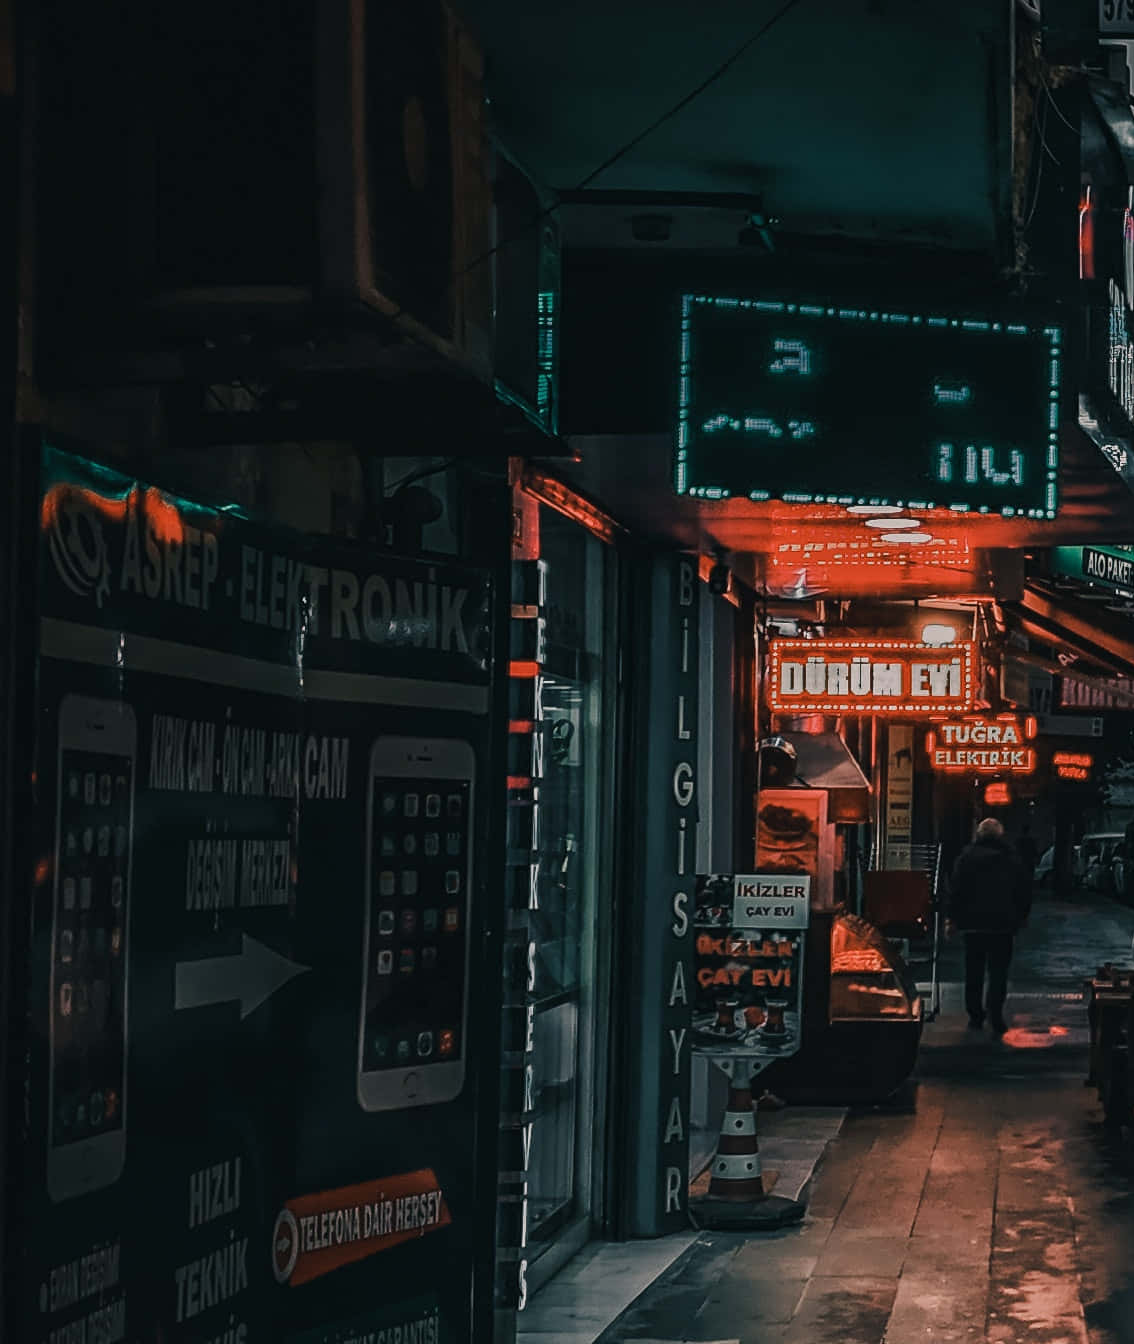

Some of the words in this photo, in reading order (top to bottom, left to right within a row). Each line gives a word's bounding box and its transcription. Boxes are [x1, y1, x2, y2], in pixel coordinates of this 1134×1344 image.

[1087, 550, 1106, 578] ALO
[240, 544, 472, 655] ELEKTRONİK
[780, 656, 903, 697] DÜRÜM
[911, 657, 961, 698] EVİ
[941, 720, 1019, 745] TUĞRA
[304, 735, 350, 799] CAM
[934, 747, 1024, 766] ELEKTRİK
[663, 560, 696, 1214] BİLGİSAYAR
[737, 881, 806, 898] İKİZLER
[745, 906, 771, 918] ÇAY
[774, 904, 795, 918] EVİ
[697, 967, 745, 990] ÇAY
[751, 967, 792, 988] EVİ
[189, 1155, 242, 1230] HIZLI
[299, 1206, 361, 1254] TELEFONA
[363, 1191, 393, 1239] DAİR
[395, 1190, 443, 1237] HERŞEY
[175, 1227, 249, 1324] TEKNİK
